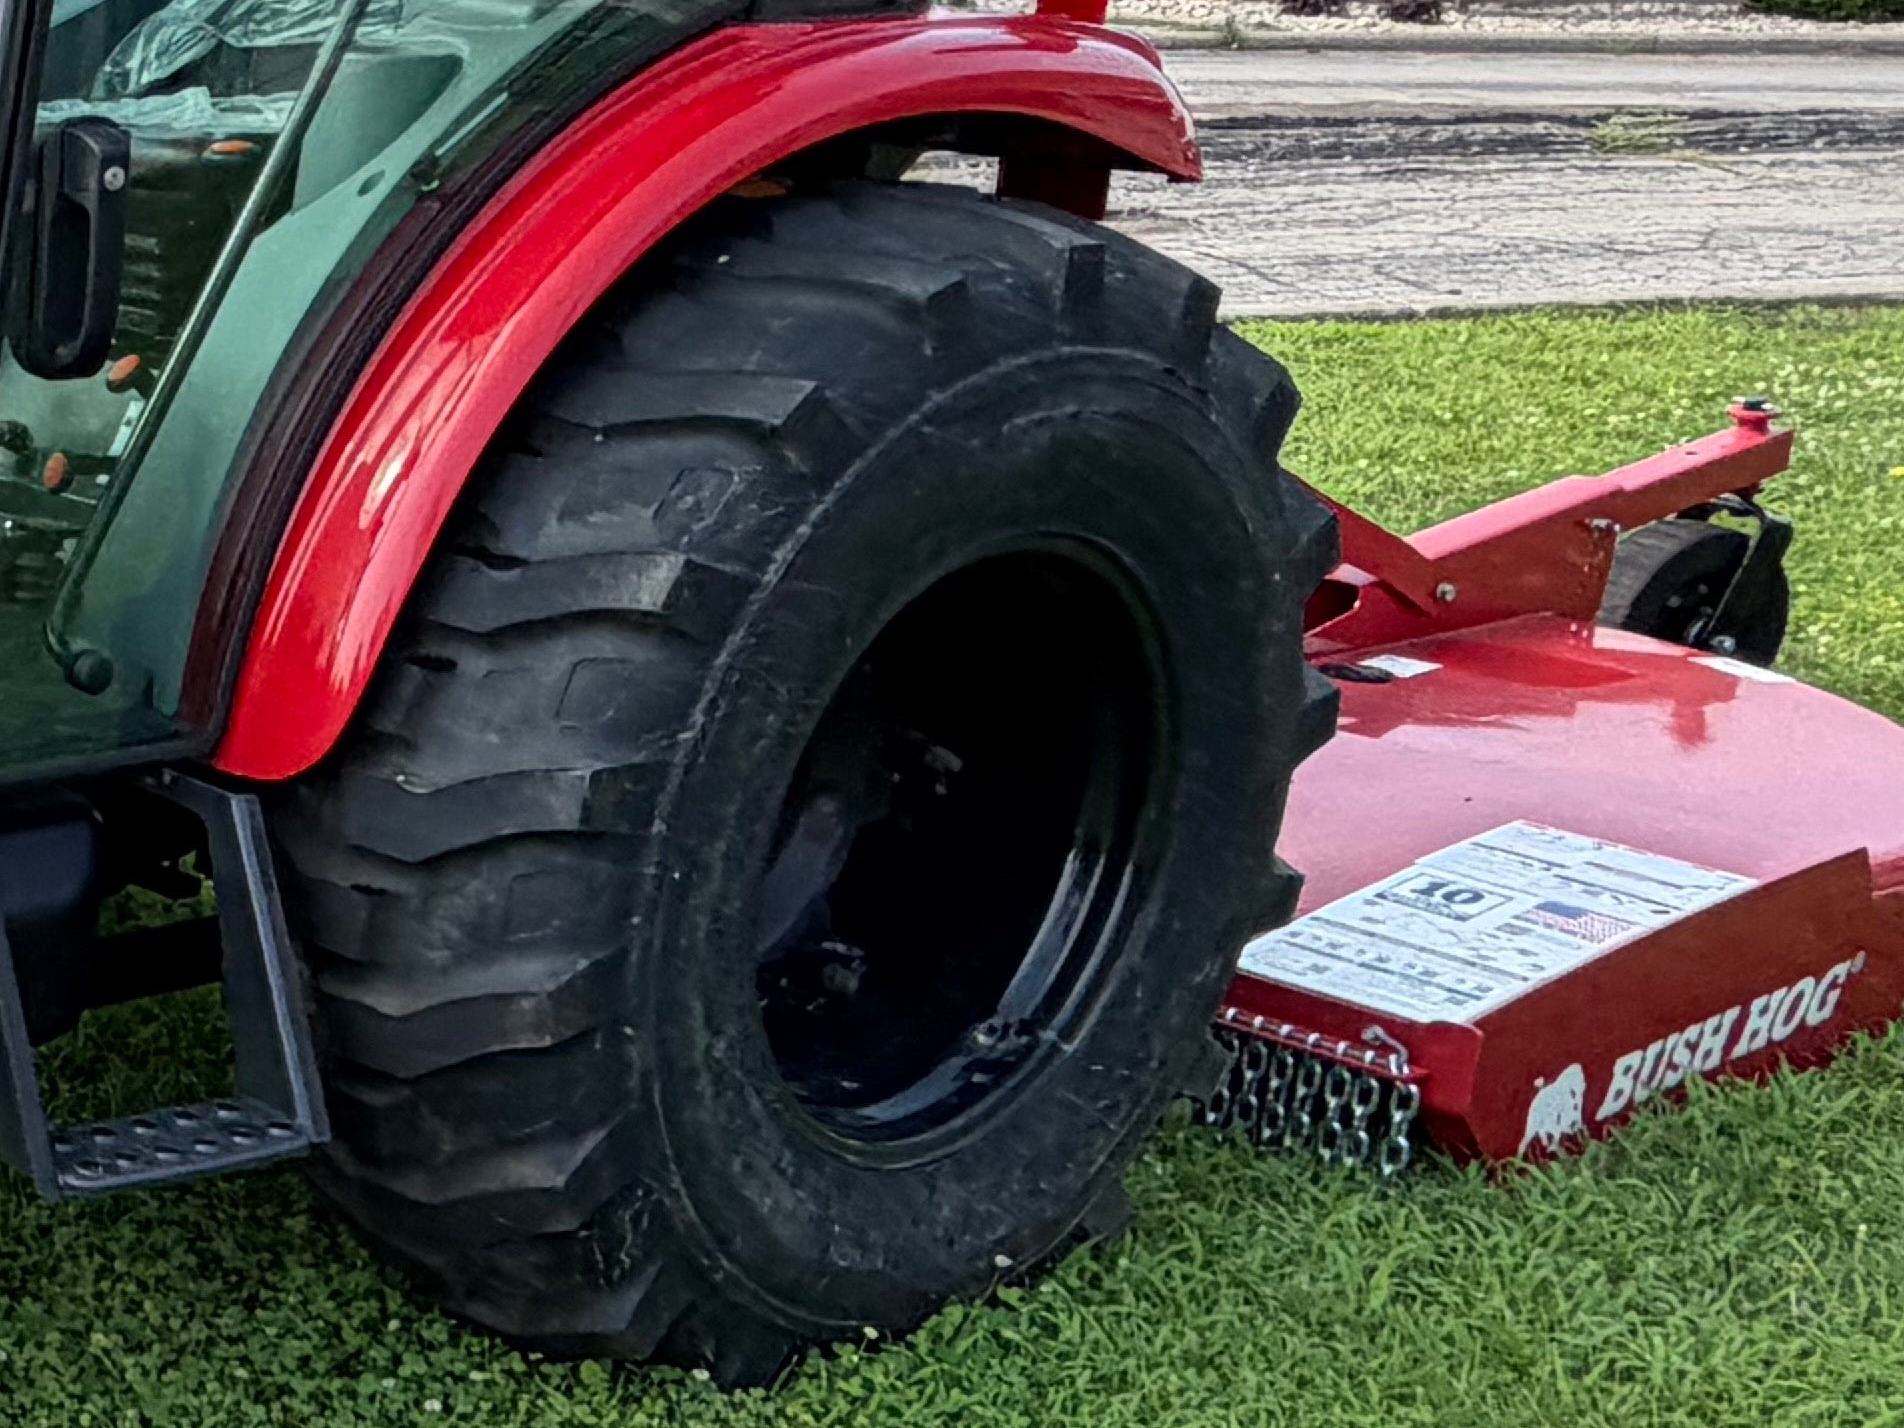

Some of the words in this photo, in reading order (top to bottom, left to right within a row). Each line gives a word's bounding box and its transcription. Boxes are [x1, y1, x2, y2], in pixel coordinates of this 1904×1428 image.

[1409, 880, 1486, 904] 10
[1594, 1005, 1742, 1121] BUSH
[1728, 958, 1853, 1060] HOG
